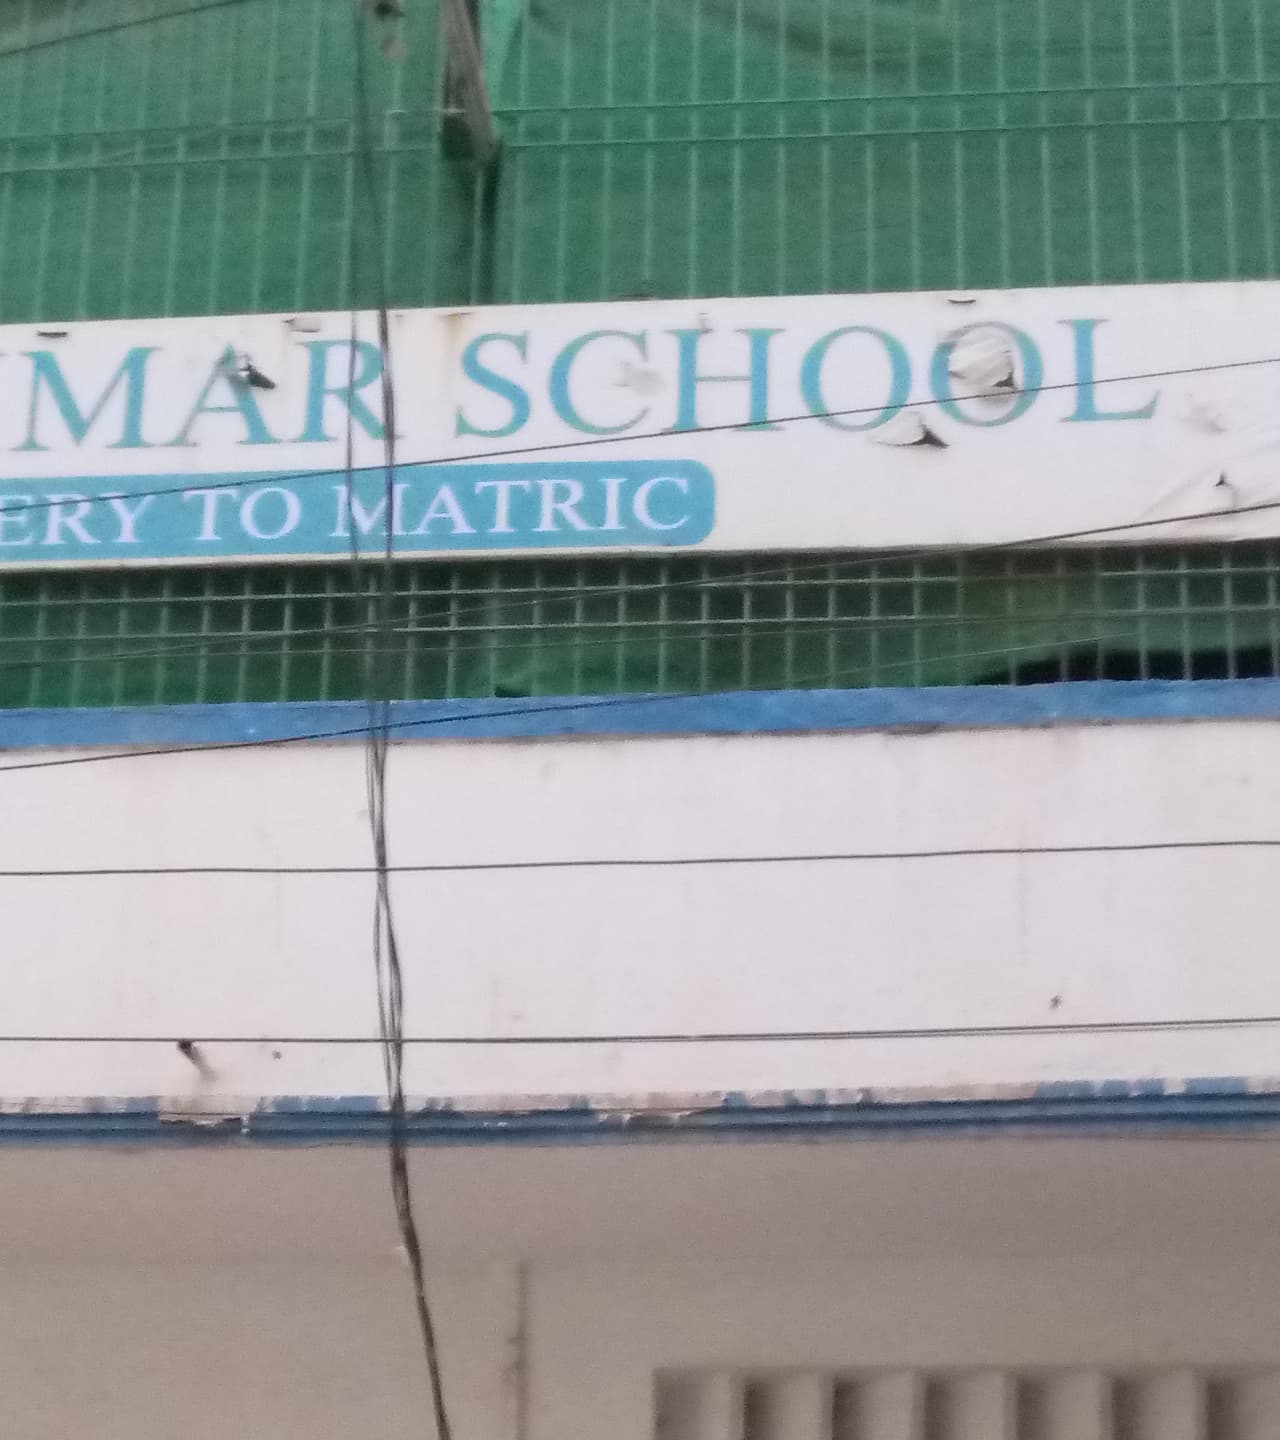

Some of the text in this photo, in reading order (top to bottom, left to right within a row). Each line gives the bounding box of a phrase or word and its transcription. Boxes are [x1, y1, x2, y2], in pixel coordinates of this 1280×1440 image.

[455, 316, 1160, 440] SCHOOL
[180, 486, 304, 543] TO
[331, 475, 692, 541] MATRIC
